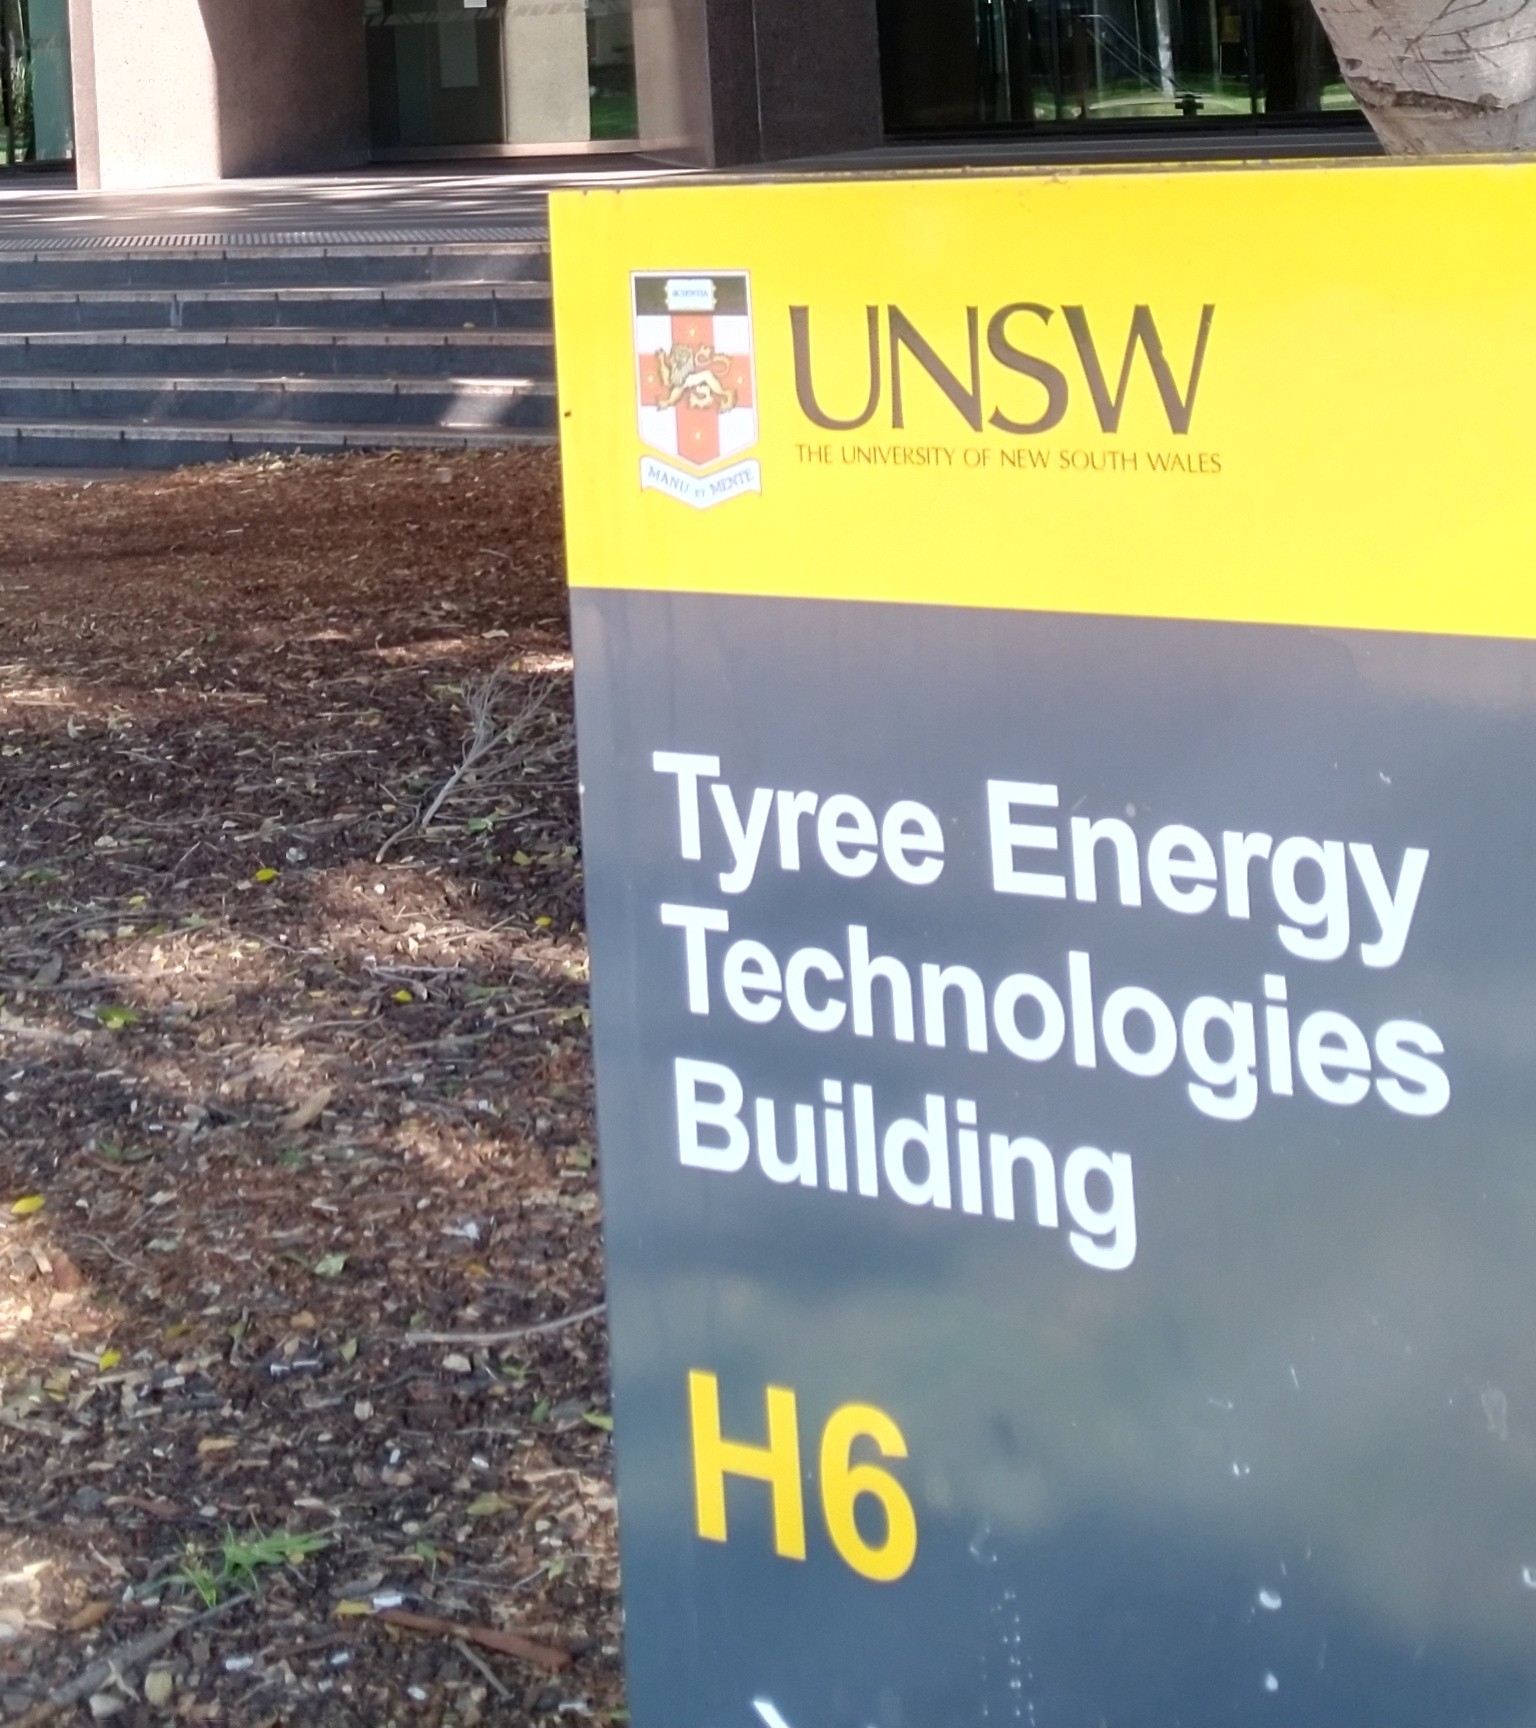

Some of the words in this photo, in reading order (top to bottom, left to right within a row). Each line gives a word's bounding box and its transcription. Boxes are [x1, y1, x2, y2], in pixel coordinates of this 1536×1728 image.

[788, 302, 1216, 436] UNSW
[795, 443, 833, 464] THE
[841, 445, 956, 467] UNIVERSITY
[963, 447, 991, 468] OF
[1000, 448, 1051, 469] NEW
[1059, 449, 1138, 471] SOUTH
[1146, 452, 1223, 474] WALES
[648, 465, 690, 494] MANU
[710, 468, 755, 496] MENTE
[652, 749, 946, 896] Tyree
[986, 778, 1430, 969] Energy
[659, 902, 1452, 1121] Technologies
[673, 1056, 1139, 1271] Building
[688, 1369, 919, 1584] H6
